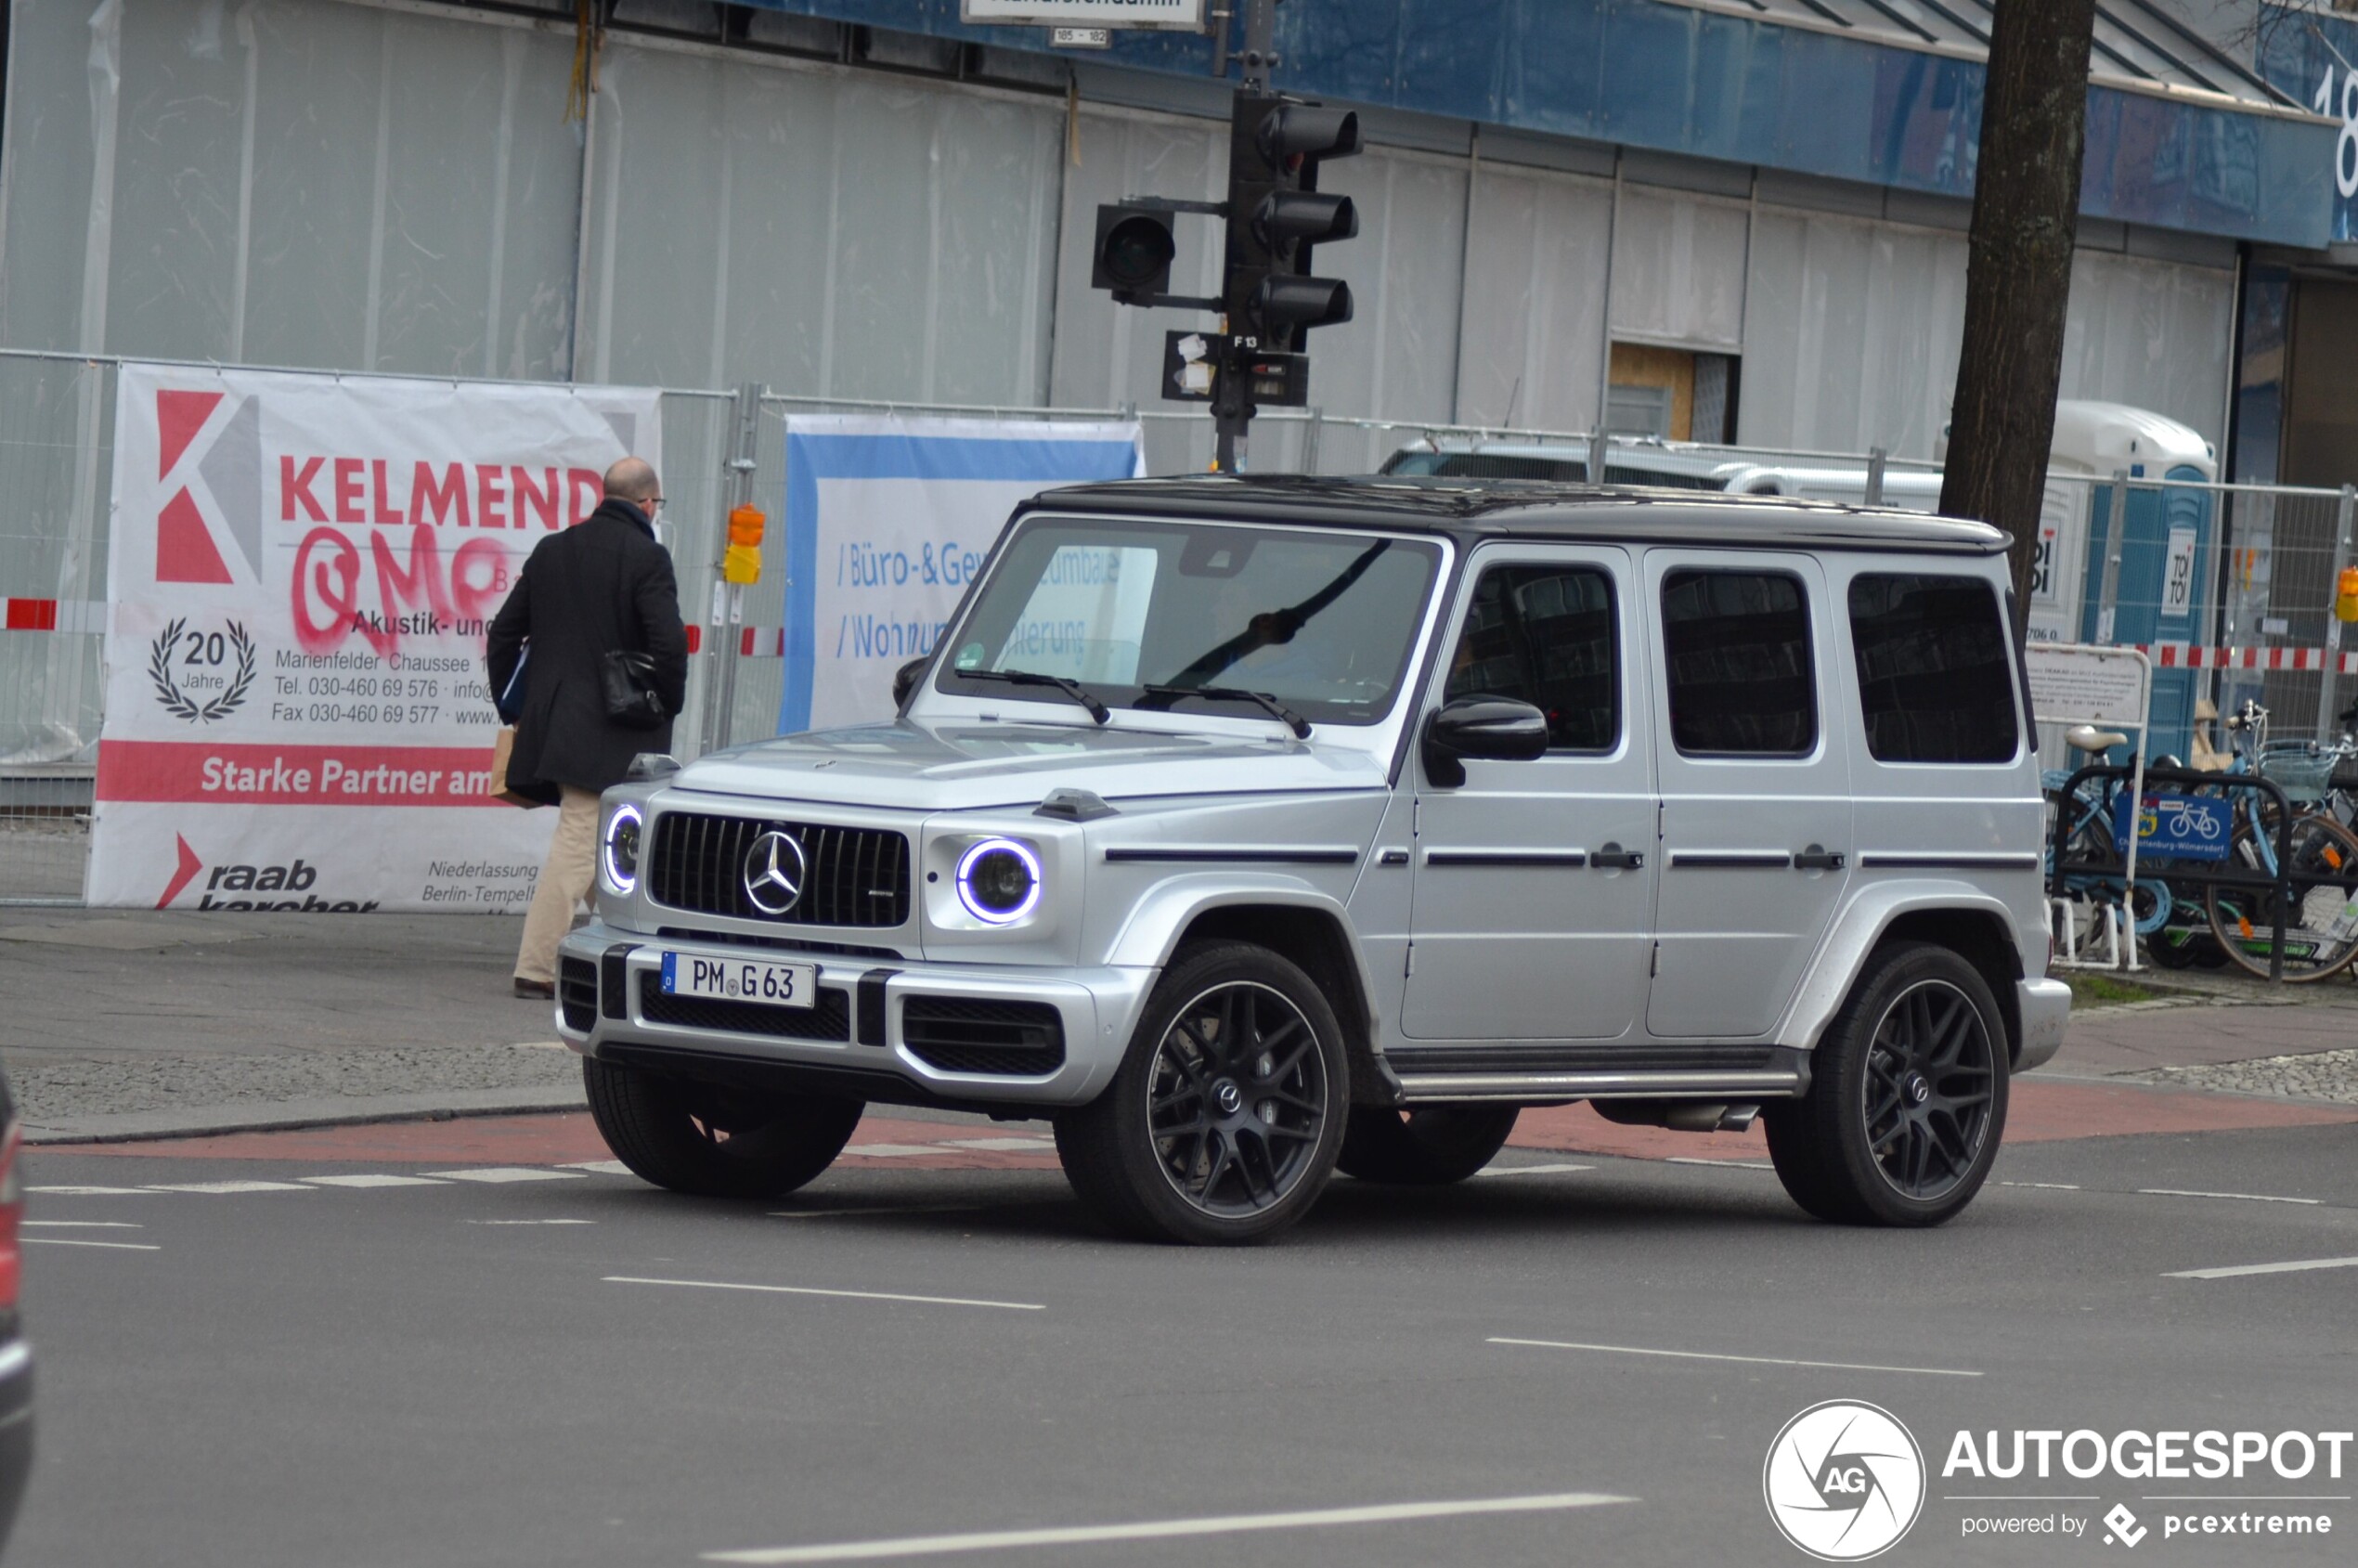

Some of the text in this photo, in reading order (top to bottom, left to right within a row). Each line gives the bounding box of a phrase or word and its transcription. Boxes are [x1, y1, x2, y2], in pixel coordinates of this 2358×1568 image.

[1089, 31, 1106, 42] 182
[1234, 335, 1257, 347] F 13
[2174, 554, 2190, 578] TOI
[2170, 580, 2186, 604] TOI
[351, 610, 449, 635] Akustik-
[184, 631, 226, 665] 20
[276, 650, 381, 670] Marienfelder
[389, 652, 470, 672] Chaussee
[181, 673, 224, 691] Jahre
[275, 676, 303, 694] Tel.
[308, 677, 378, 696] 030-460
[382, 679, 403, 697] 69
[408, 680, 438, 698] 576
[272, 703, 304, 721] Fax
[309, 704, 378, 722] 030-460
[383, 706, 404, 723] 69
[408, 706, 439, 724] 577
[201, 756, 493, 797] Starke Partner am
[2118, 837, 2224, 853] Chottenburg-Wilmersdorf
[206, 859, 317, 891] raab
[428, 861, 538, 882] Niederlassung
[693, 960, 724, 993] PM
